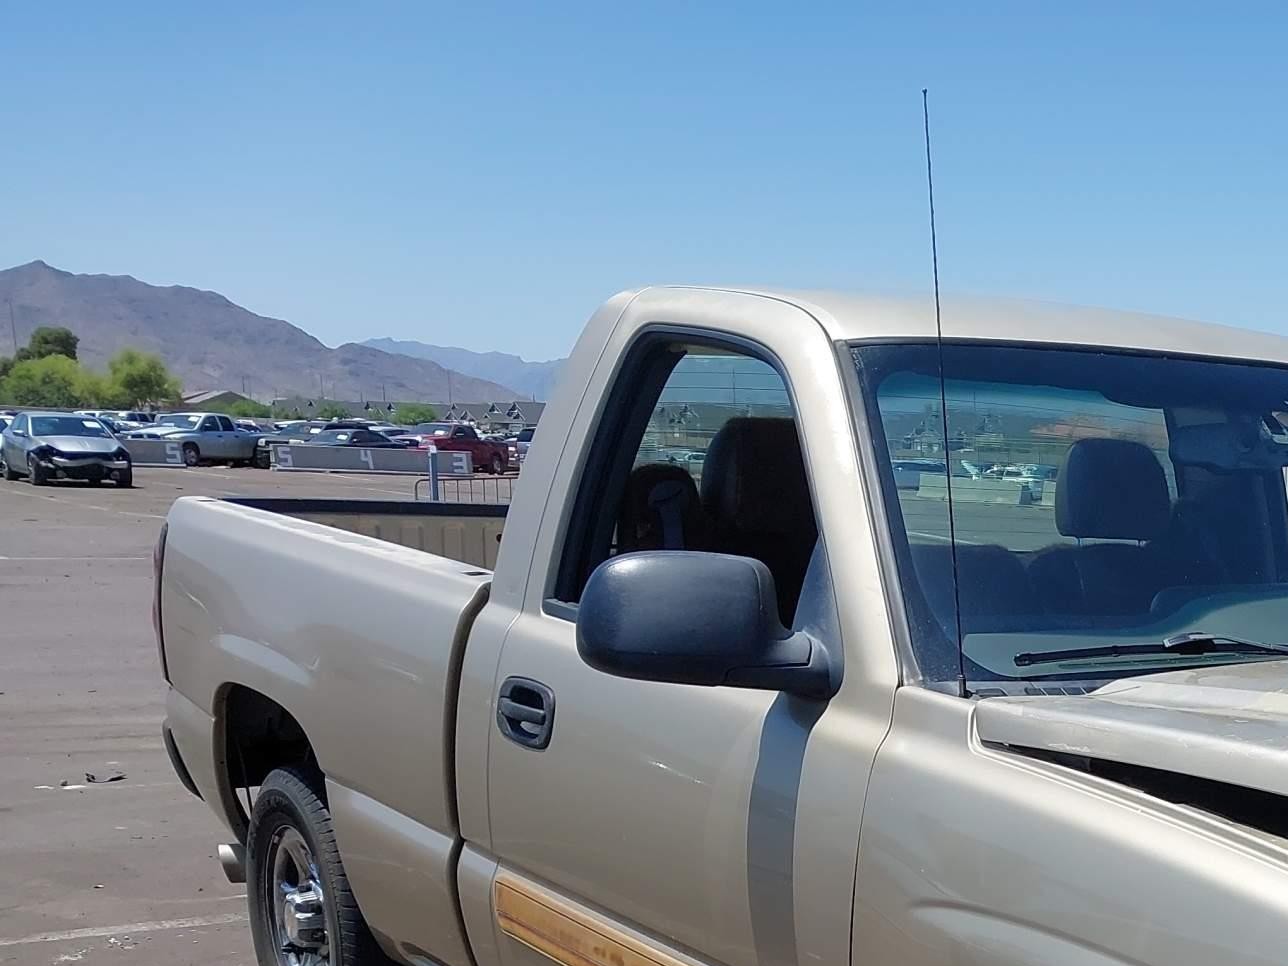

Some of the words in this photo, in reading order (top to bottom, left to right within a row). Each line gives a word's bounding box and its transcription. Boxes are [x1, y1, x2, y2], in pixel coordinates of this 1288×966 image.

[165, 443, 182, 463] 5
[278, 447, 295, 467] 5
[360, 449, 375, 470] 4
[452, 453, 467, 473] 3
